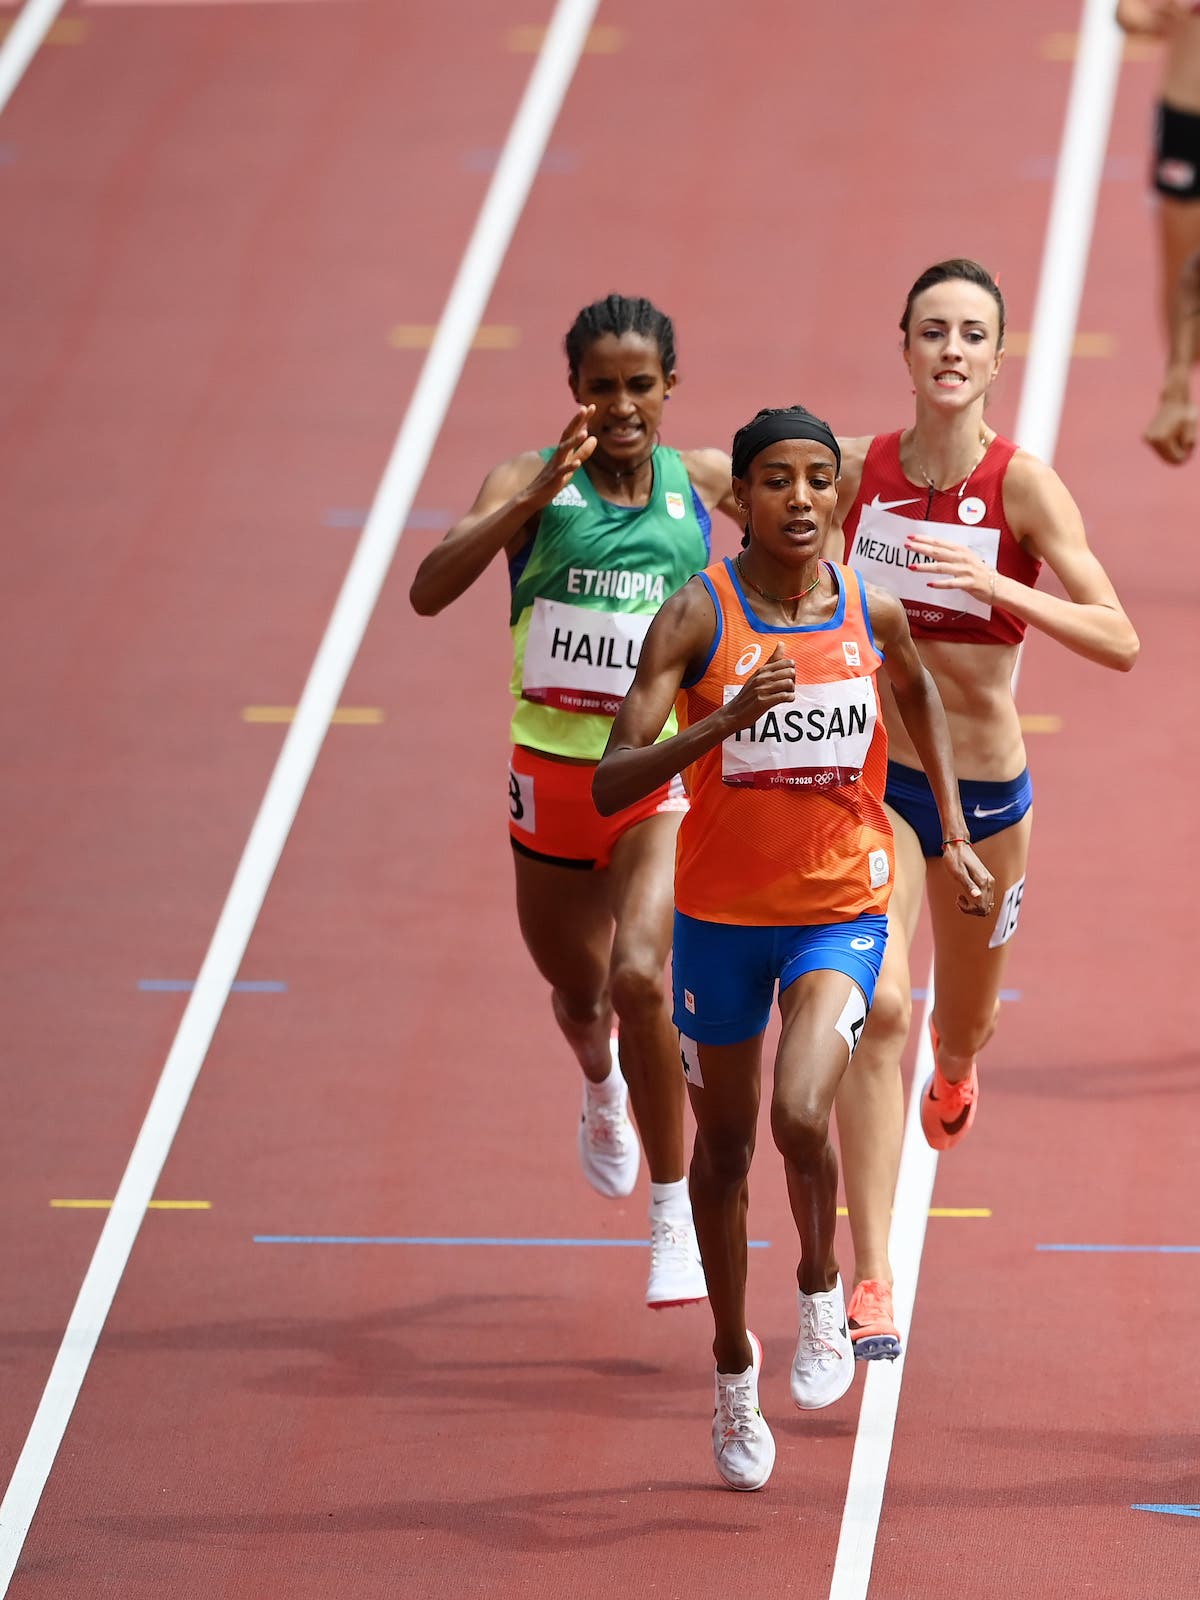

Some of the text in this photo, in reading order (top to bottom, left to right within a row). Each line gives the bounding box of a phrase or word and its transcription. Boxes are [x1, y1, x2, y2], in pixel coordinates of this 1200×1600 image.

[567, 567, 665, 601] ETHIOPIA
[769, 775, 813, 785] TOKYO 2020
